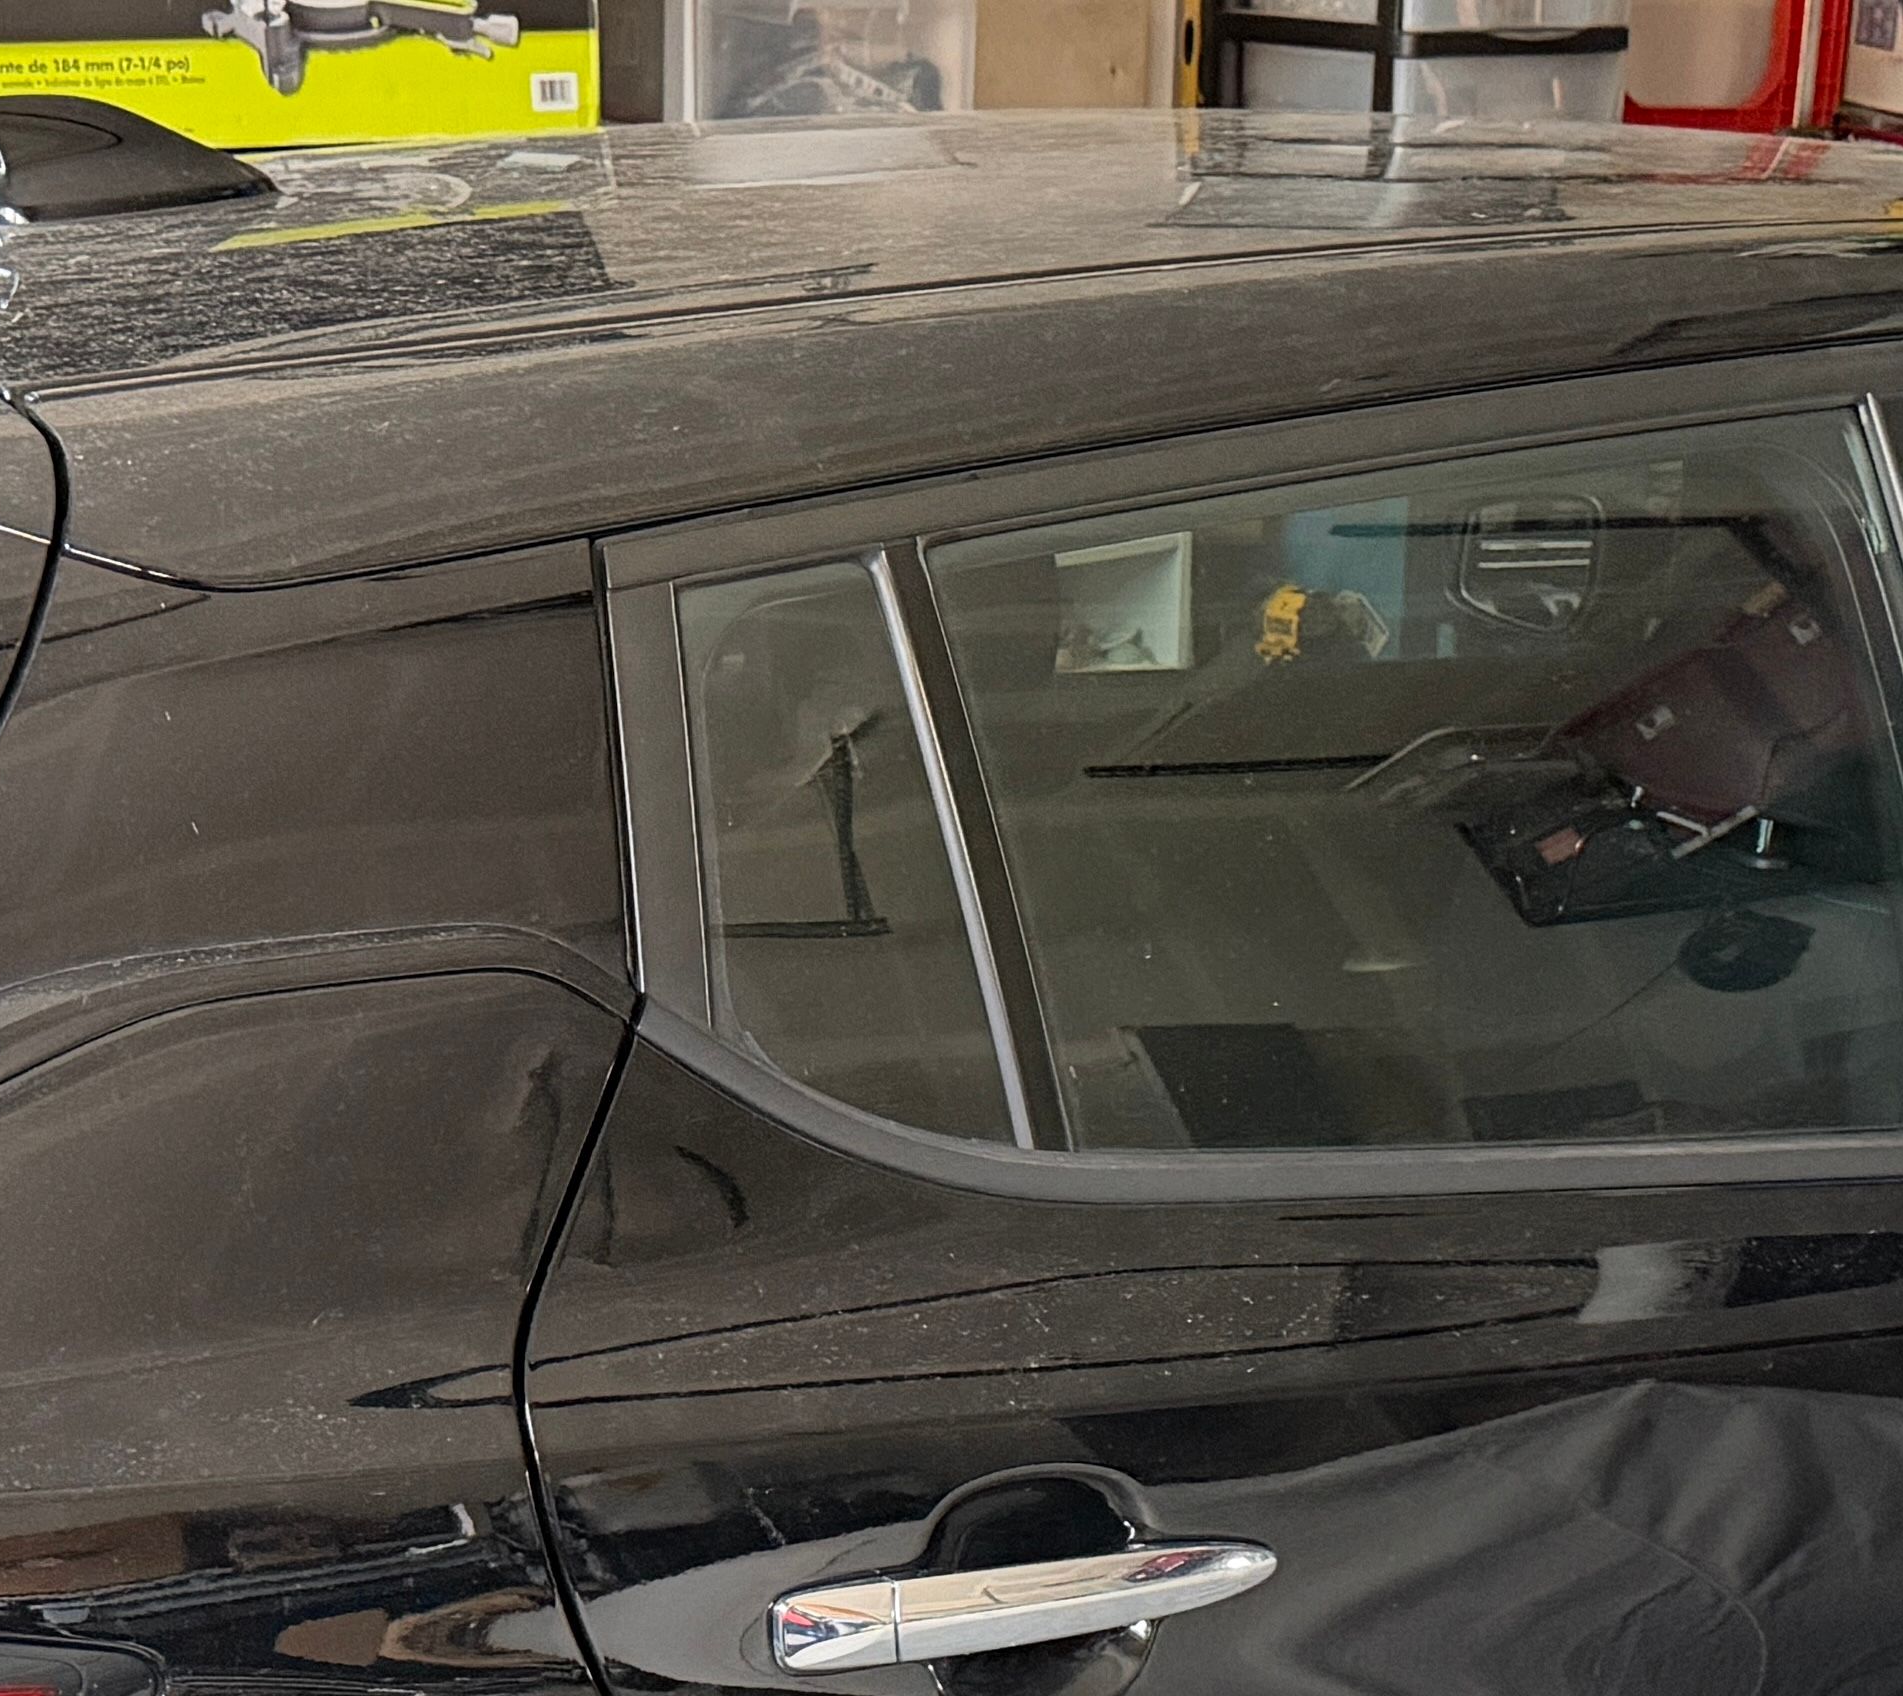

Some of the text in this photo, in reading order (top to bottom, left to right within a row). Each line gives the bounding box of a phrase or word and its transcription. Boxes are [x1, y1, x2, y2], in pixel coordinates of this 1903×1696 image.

[28, 59, 48, 74] de
[52, 58, 81, 73] 184
[85, 60, 115, 73] mm
[118, 56, 163, 74] (7-1/4
[166, 56, 191, 74] po)
